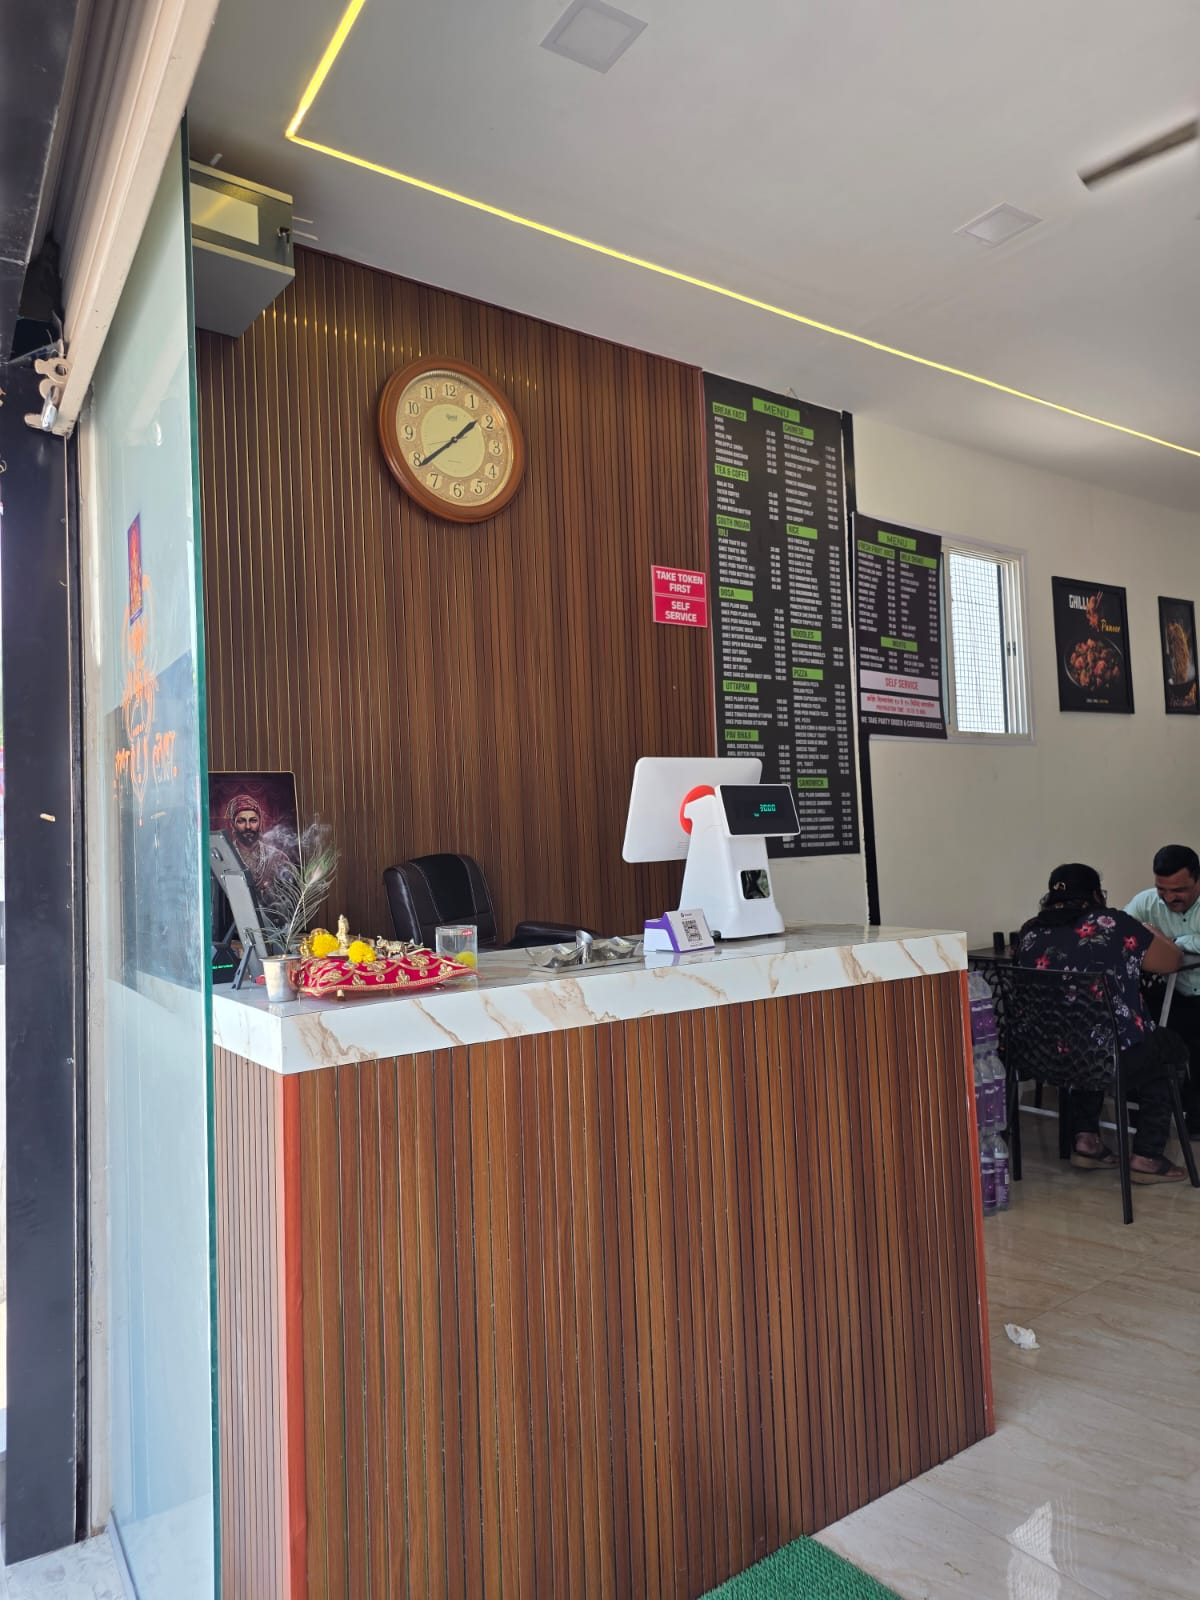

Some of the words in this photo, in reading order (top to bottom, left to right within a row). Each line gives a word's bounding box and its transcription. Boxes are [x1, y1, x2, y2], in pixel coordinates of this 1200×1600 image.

[424, 386, 433, 400] 11
[445, 384, 456, 397] 12
[408, 401, 419, 415] 10
[469, 395, 475, 409] 1
[763, 403, 789, 418] MENU
[485, 415, 494, 429] 2
[404, 425, 414, 440] 9
[492, 440, 501, 454] 3
[413, 452, 421, 466] 8
[488, 465, 497, 479] 4
[716, 464, 726, 475] TEA
[430, 473, 439, 488] 7
[474, 480, 483, 494] 5
[453, 483, 462, 498] 6
[886, 535, 908, 548] MENU
[656, 571, 676, 582] TAKE
[678, 574, 703, 585] TOKEN
[669, 583, 691, 594] FIRST
[671, 601, 690, 611] SELF
[665, 611, 698, 623] SERVICE
[793, 669, 808, 678] PIZZA
[725, 682, 750, 691] UTTAPAM
[885, 677, 898, 688] SELF
[898, 679, 919, 690] SERVICE
[868, 716, 878, 725] TAKE
[878, 717, 891, 725] PARTY
